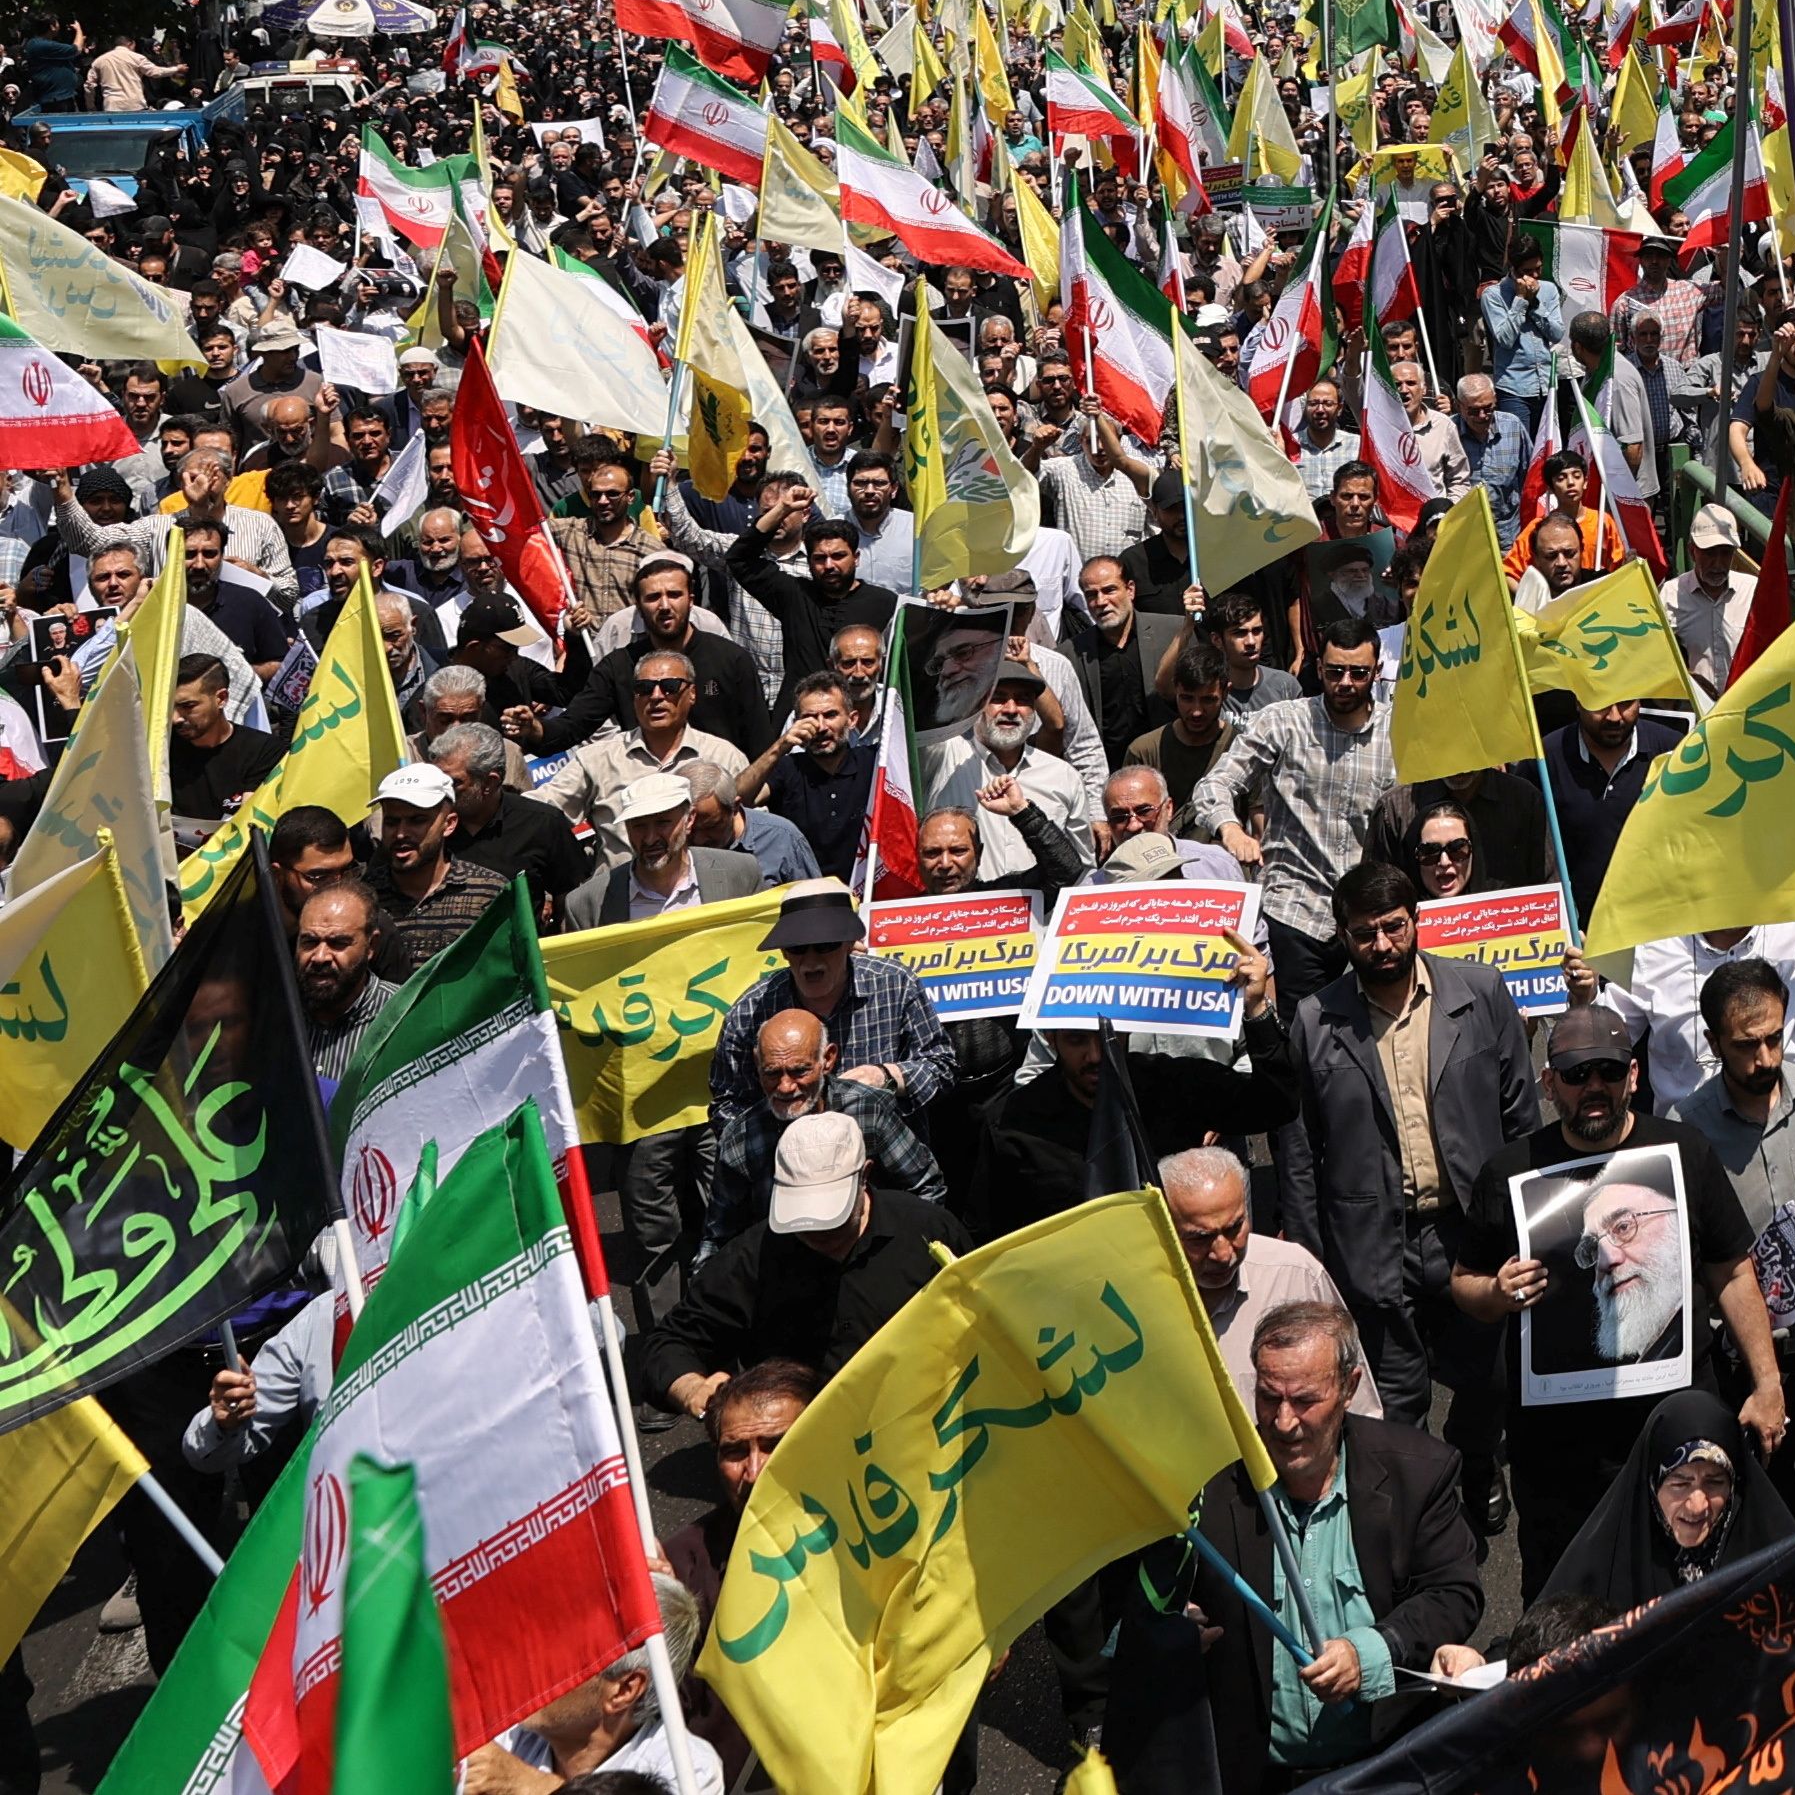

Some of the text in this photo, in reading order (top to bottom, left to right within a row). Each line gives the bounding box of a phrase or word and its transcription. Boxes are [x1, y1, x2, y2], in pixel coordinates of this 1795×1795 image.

[1419, 593, 1481, 699] لشکر
[953, 938, 1035, 971] مرگ بر
[1060, 934, 1239, 973] مرگ بر آمریکا
[1490, 948, 1510, 970] بر
[1514, 936, 1565, 963] مرگ
[939, 979, 994, 1001] WITH
[1046, 984, 1230, 1012] DOWN WITH USA
[1505, 975, 1568, 997] TH USA
[716, 1280, 1148, 1665] لشکر قدس
